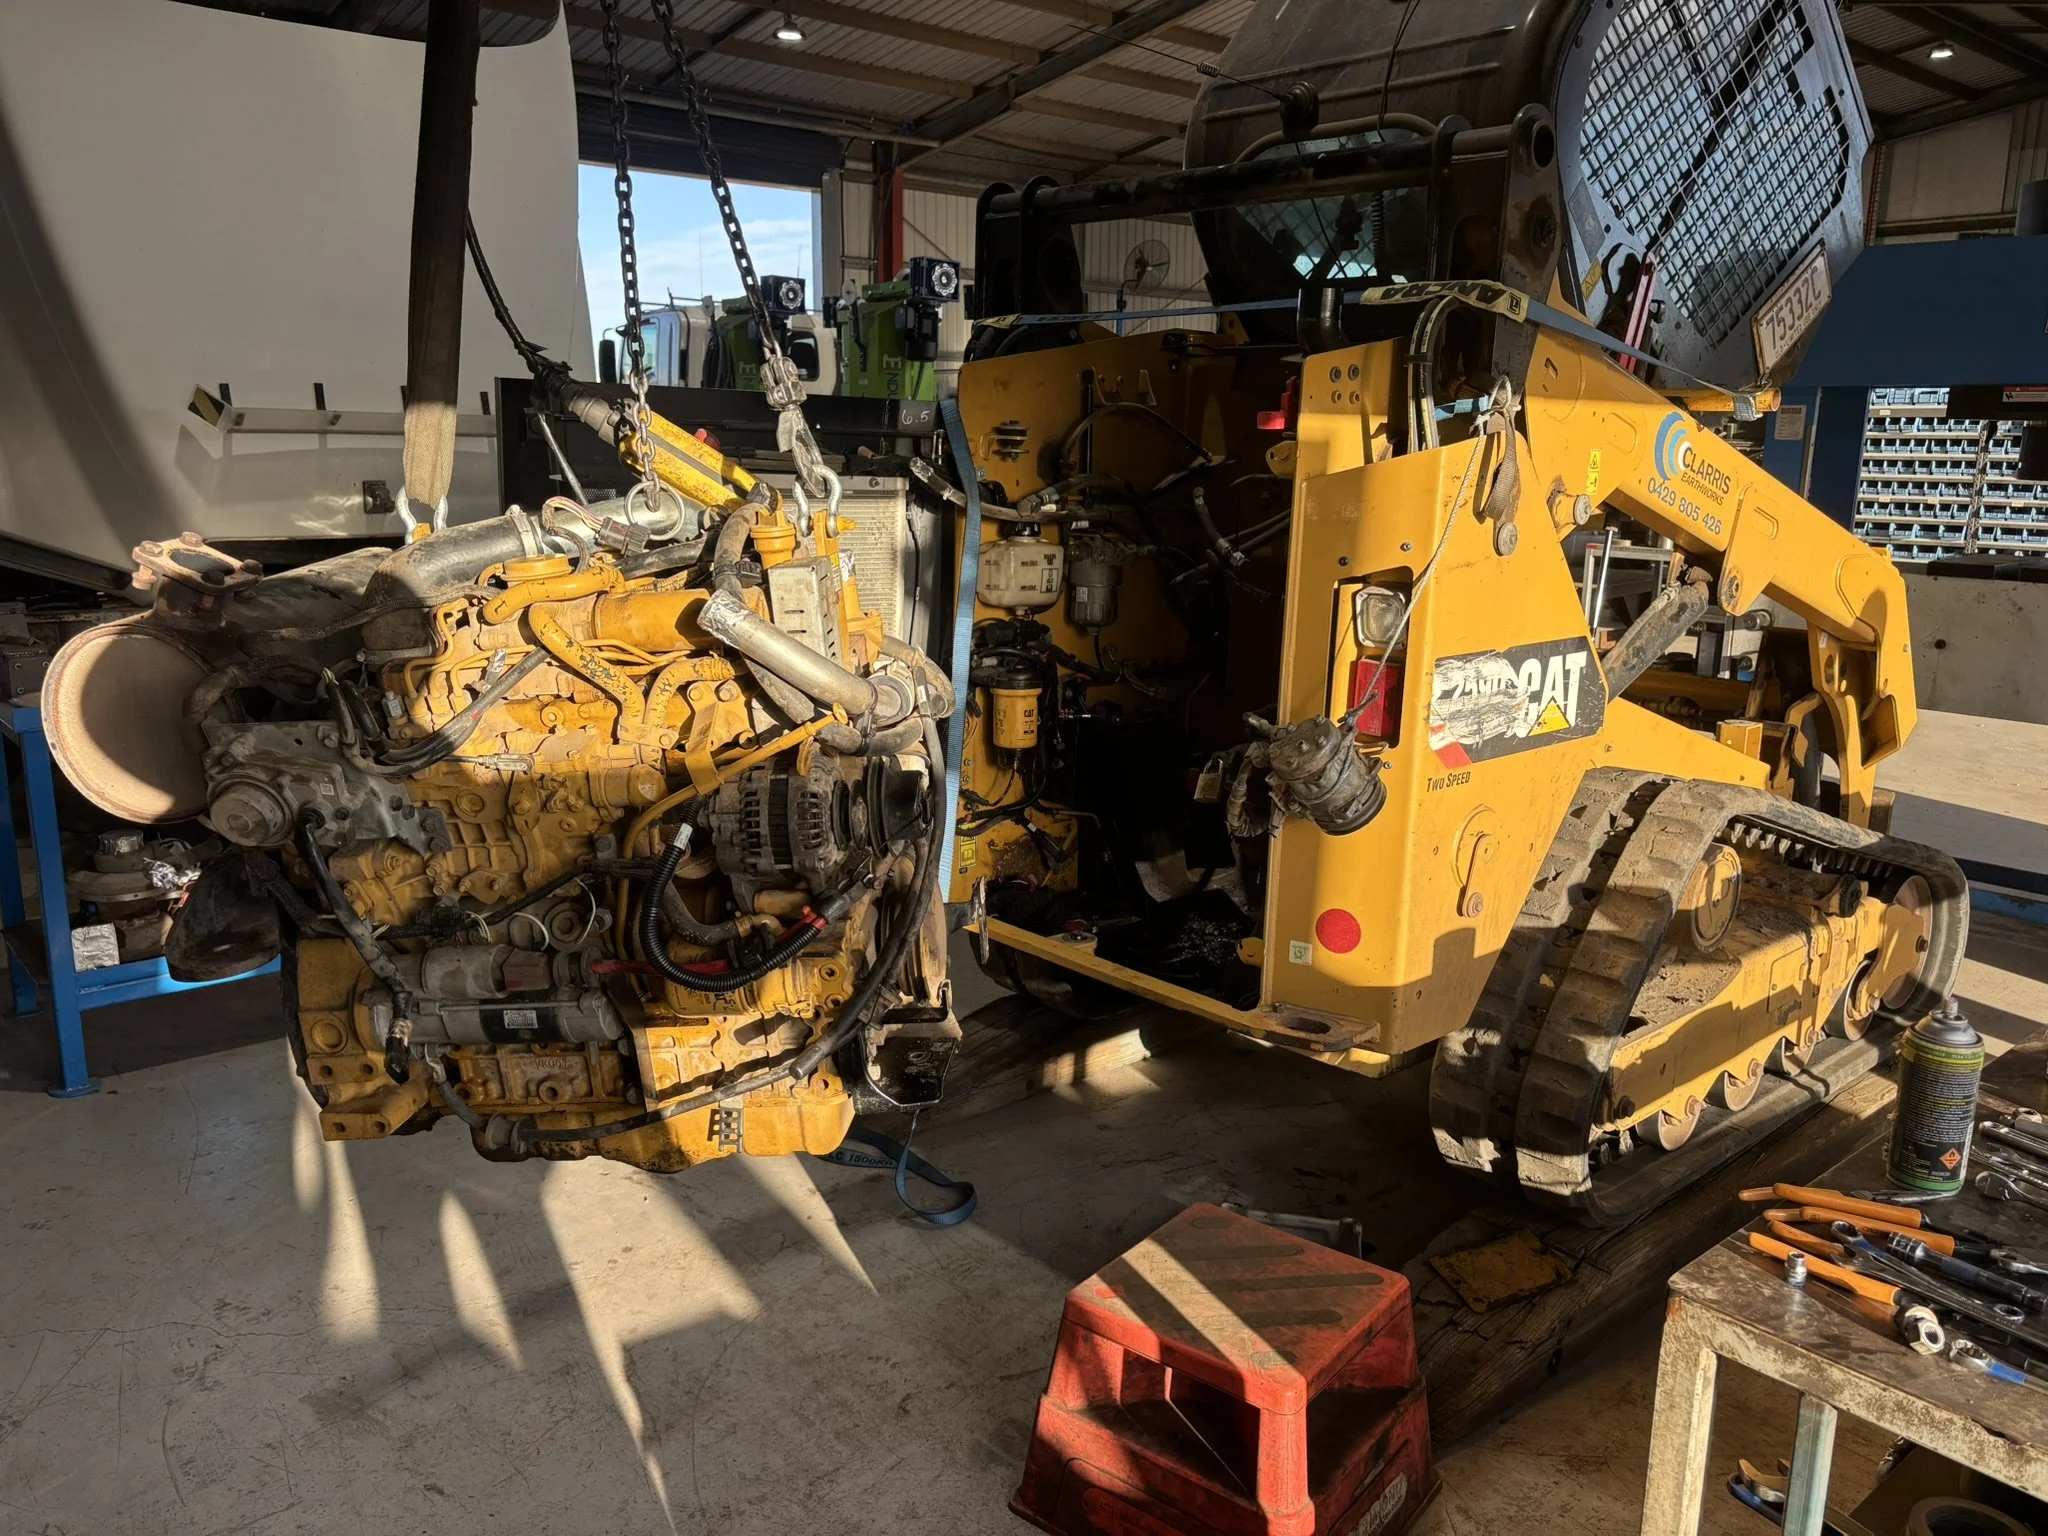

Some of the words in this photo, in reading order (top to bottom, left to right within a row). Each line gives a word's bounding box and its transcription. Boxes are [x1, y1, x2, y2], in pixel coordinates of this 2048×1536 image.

[1380, 280, 1507, 305] ANCRA
[1765, 265, 1821, 350] 75332C
[901, 409, 931, 425] 6.5
[1681, 472, 1725, 506] EARTHWORKS
[1682, 446, 1731, 495] CLARRIS
[1648, 477, 1677, 507] 0429
[1679, 497, 1701, 521] 805
[1703, 512, 1722, 535] 426
[1514, 651, 1588, 739] CAT
